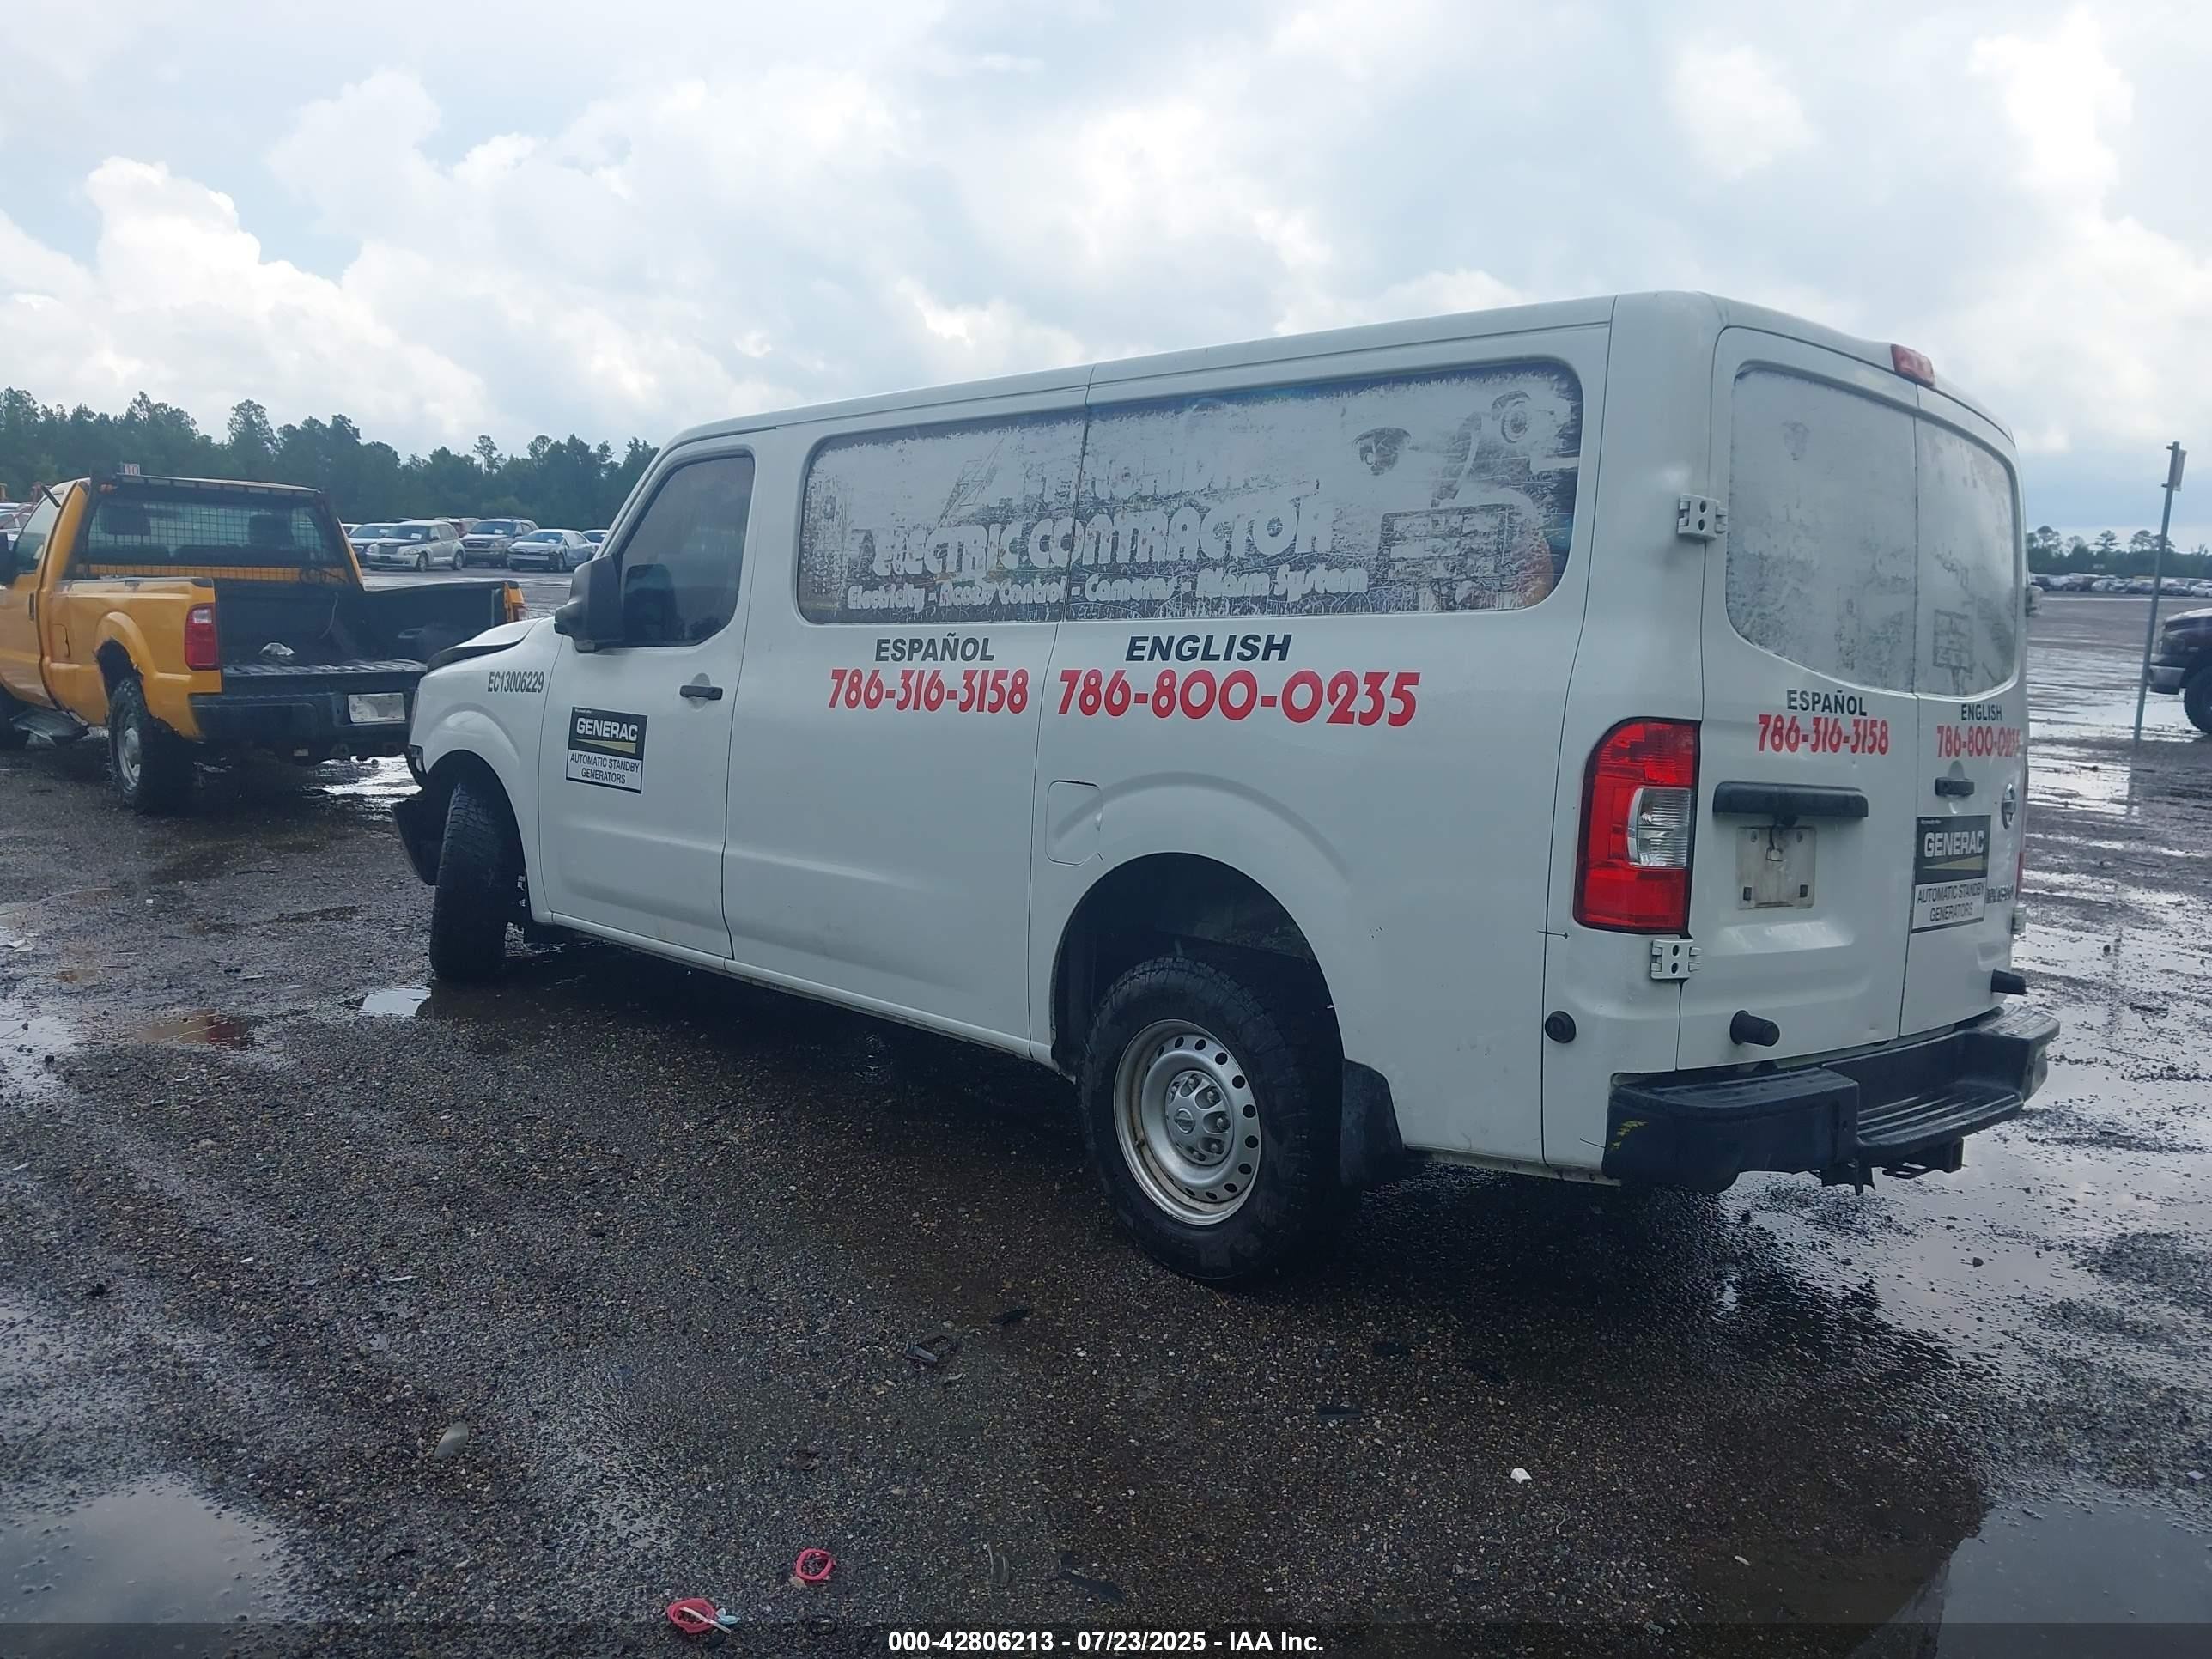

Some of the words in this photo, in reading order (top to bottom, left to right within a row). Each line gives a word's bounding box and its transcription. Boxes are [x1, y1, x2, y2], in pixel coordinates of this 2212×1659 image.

[875, 632, 995, 662] ESPAÑOL
[1125, 633, 1292, 662] ENGLISH
[488, 671, 545, 694] EC13006229
[828, 667, 1030, 714] 786-316-3158
[1057, 667, 1422, 728] 786-800-0235
[1786, 689, 1868, 717] ESPAÑOL
[1960, 703, 2002, 722] ENGLISH
[576, 717, 638, 742] GENERAC
[1758, 714, 1889, 756] 786-316-3158
[569, 753, 607, 769] AUTOMATIC
[608, 758, 641, 774] STANDBY
[580, 767, 626, 785] GENERATORS
[1923, 830, 1985, 858] GENERAC
[1917, 884, 1958, 904] AUTOMATIC
[1958, 881, 1984, 899] STANDBY
[1929, 902, 1974, 922] GENERATORS
